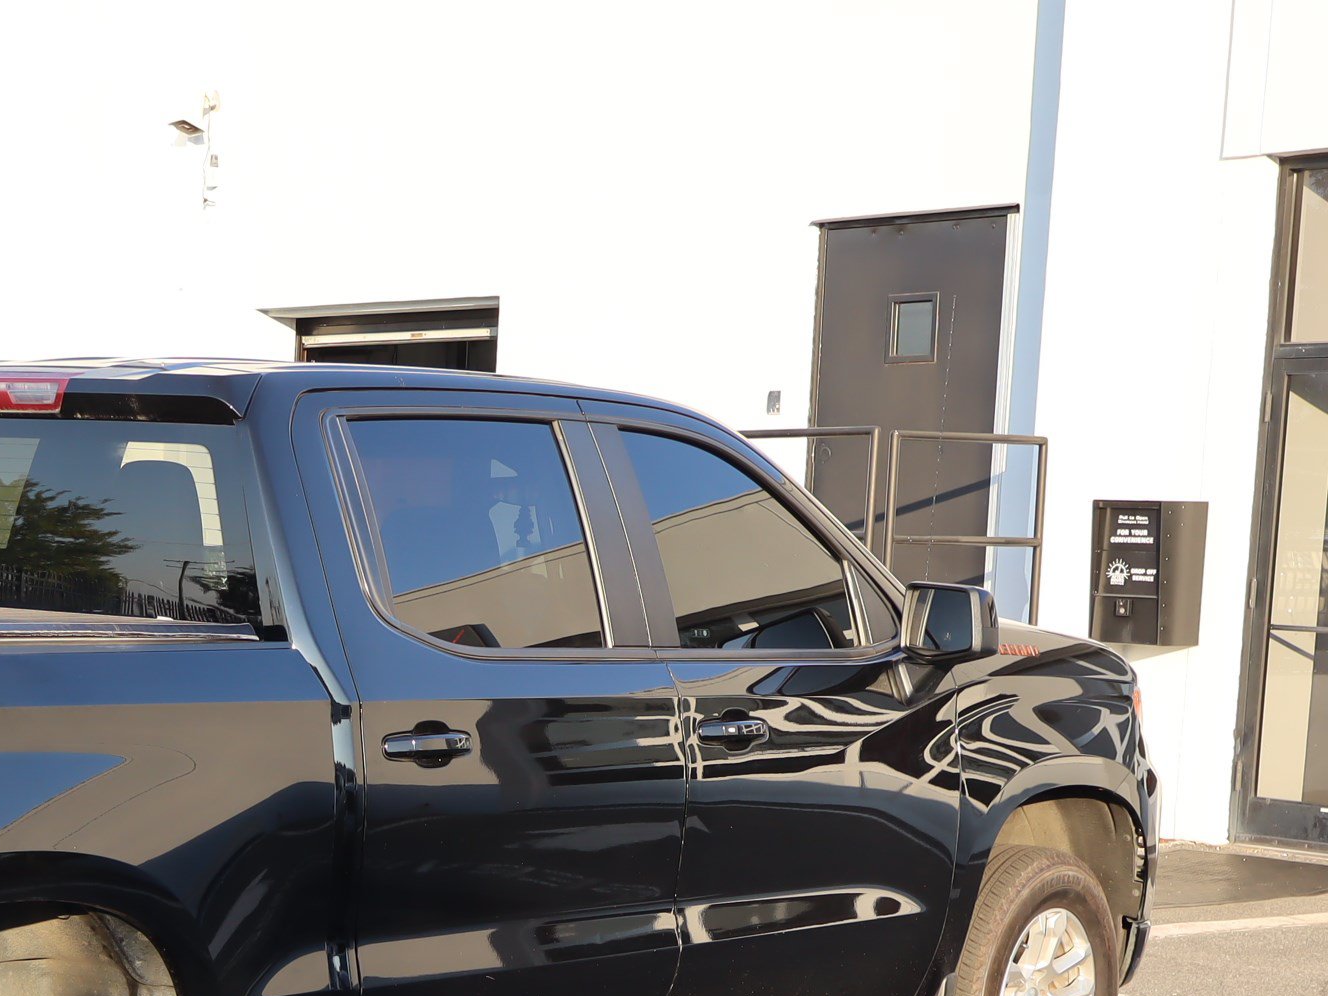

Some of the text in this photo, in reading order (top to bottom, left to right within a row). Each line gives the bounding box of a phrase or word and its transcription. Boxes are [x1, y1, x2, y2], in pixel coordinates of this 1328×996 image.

[1116, 528, 1148, 536] FOR YOUR
[1110, 536, 1154, 544] CONVENIENCE
[1130, 567, 1157, 576] DROP OFF
[1131, 574, 1155, 582] SERVICE
